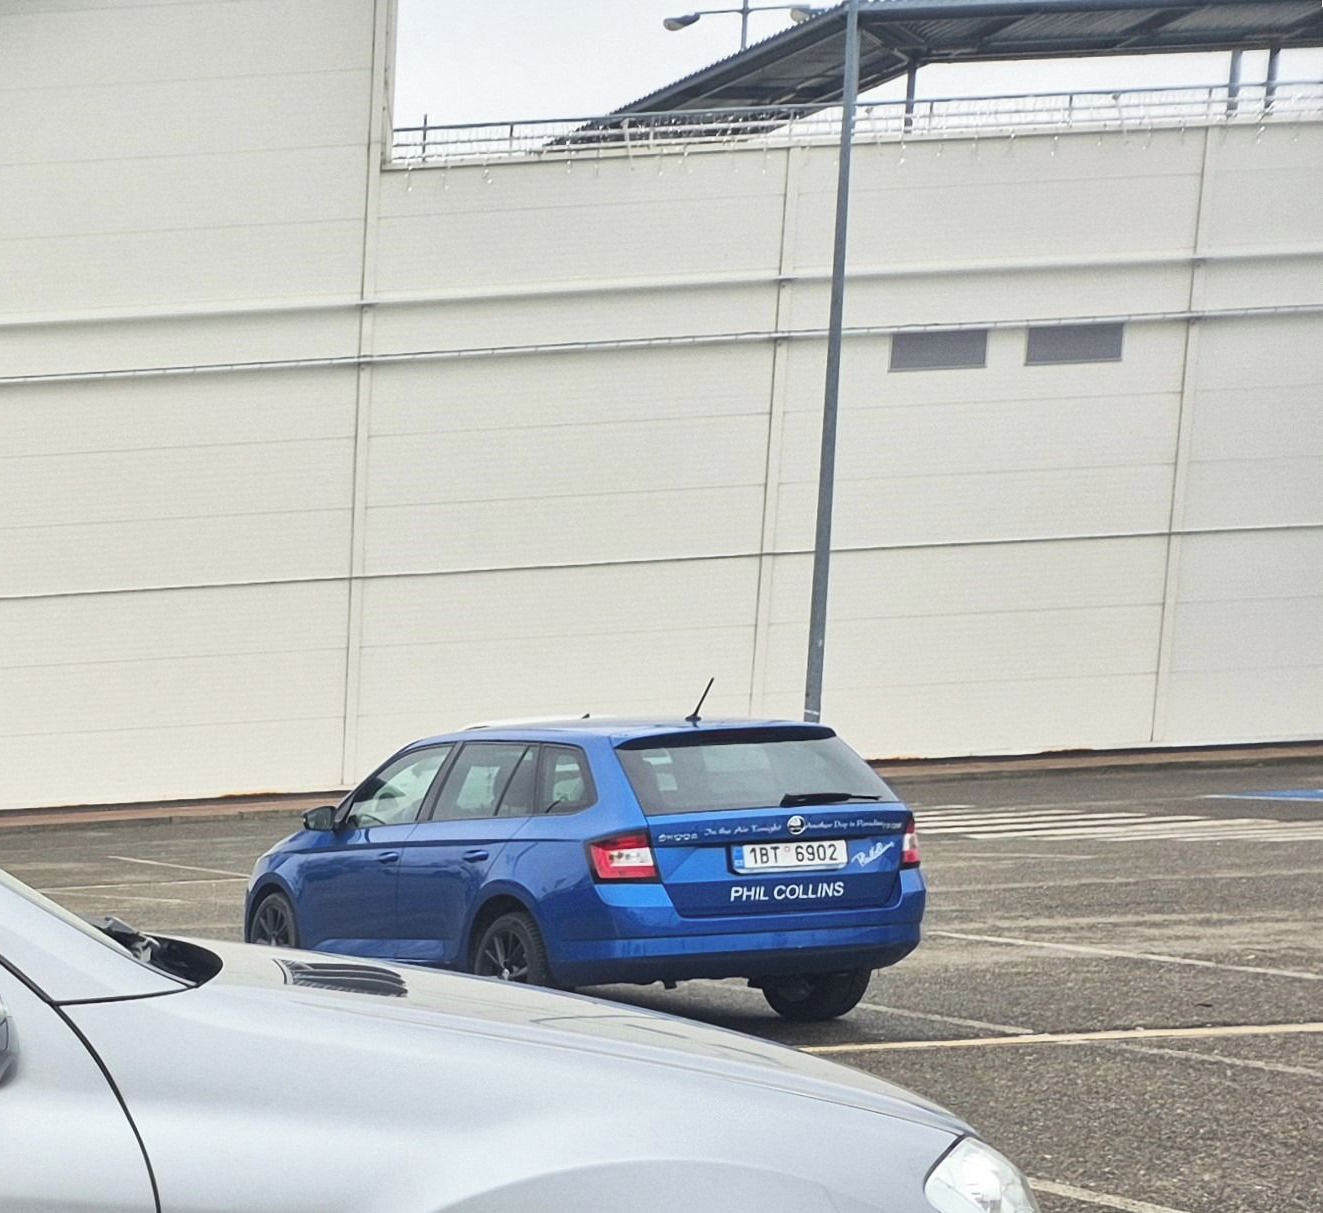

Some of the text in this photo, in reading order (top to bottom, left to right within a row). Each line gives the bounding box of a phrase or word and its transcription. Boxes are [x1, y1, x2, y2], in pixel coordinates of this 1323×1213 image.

[749, 846, 780, 864] 1BT
[795, 843, 838, 861] 6902
[730, 882, 844, 901] PHIL COLLINS
